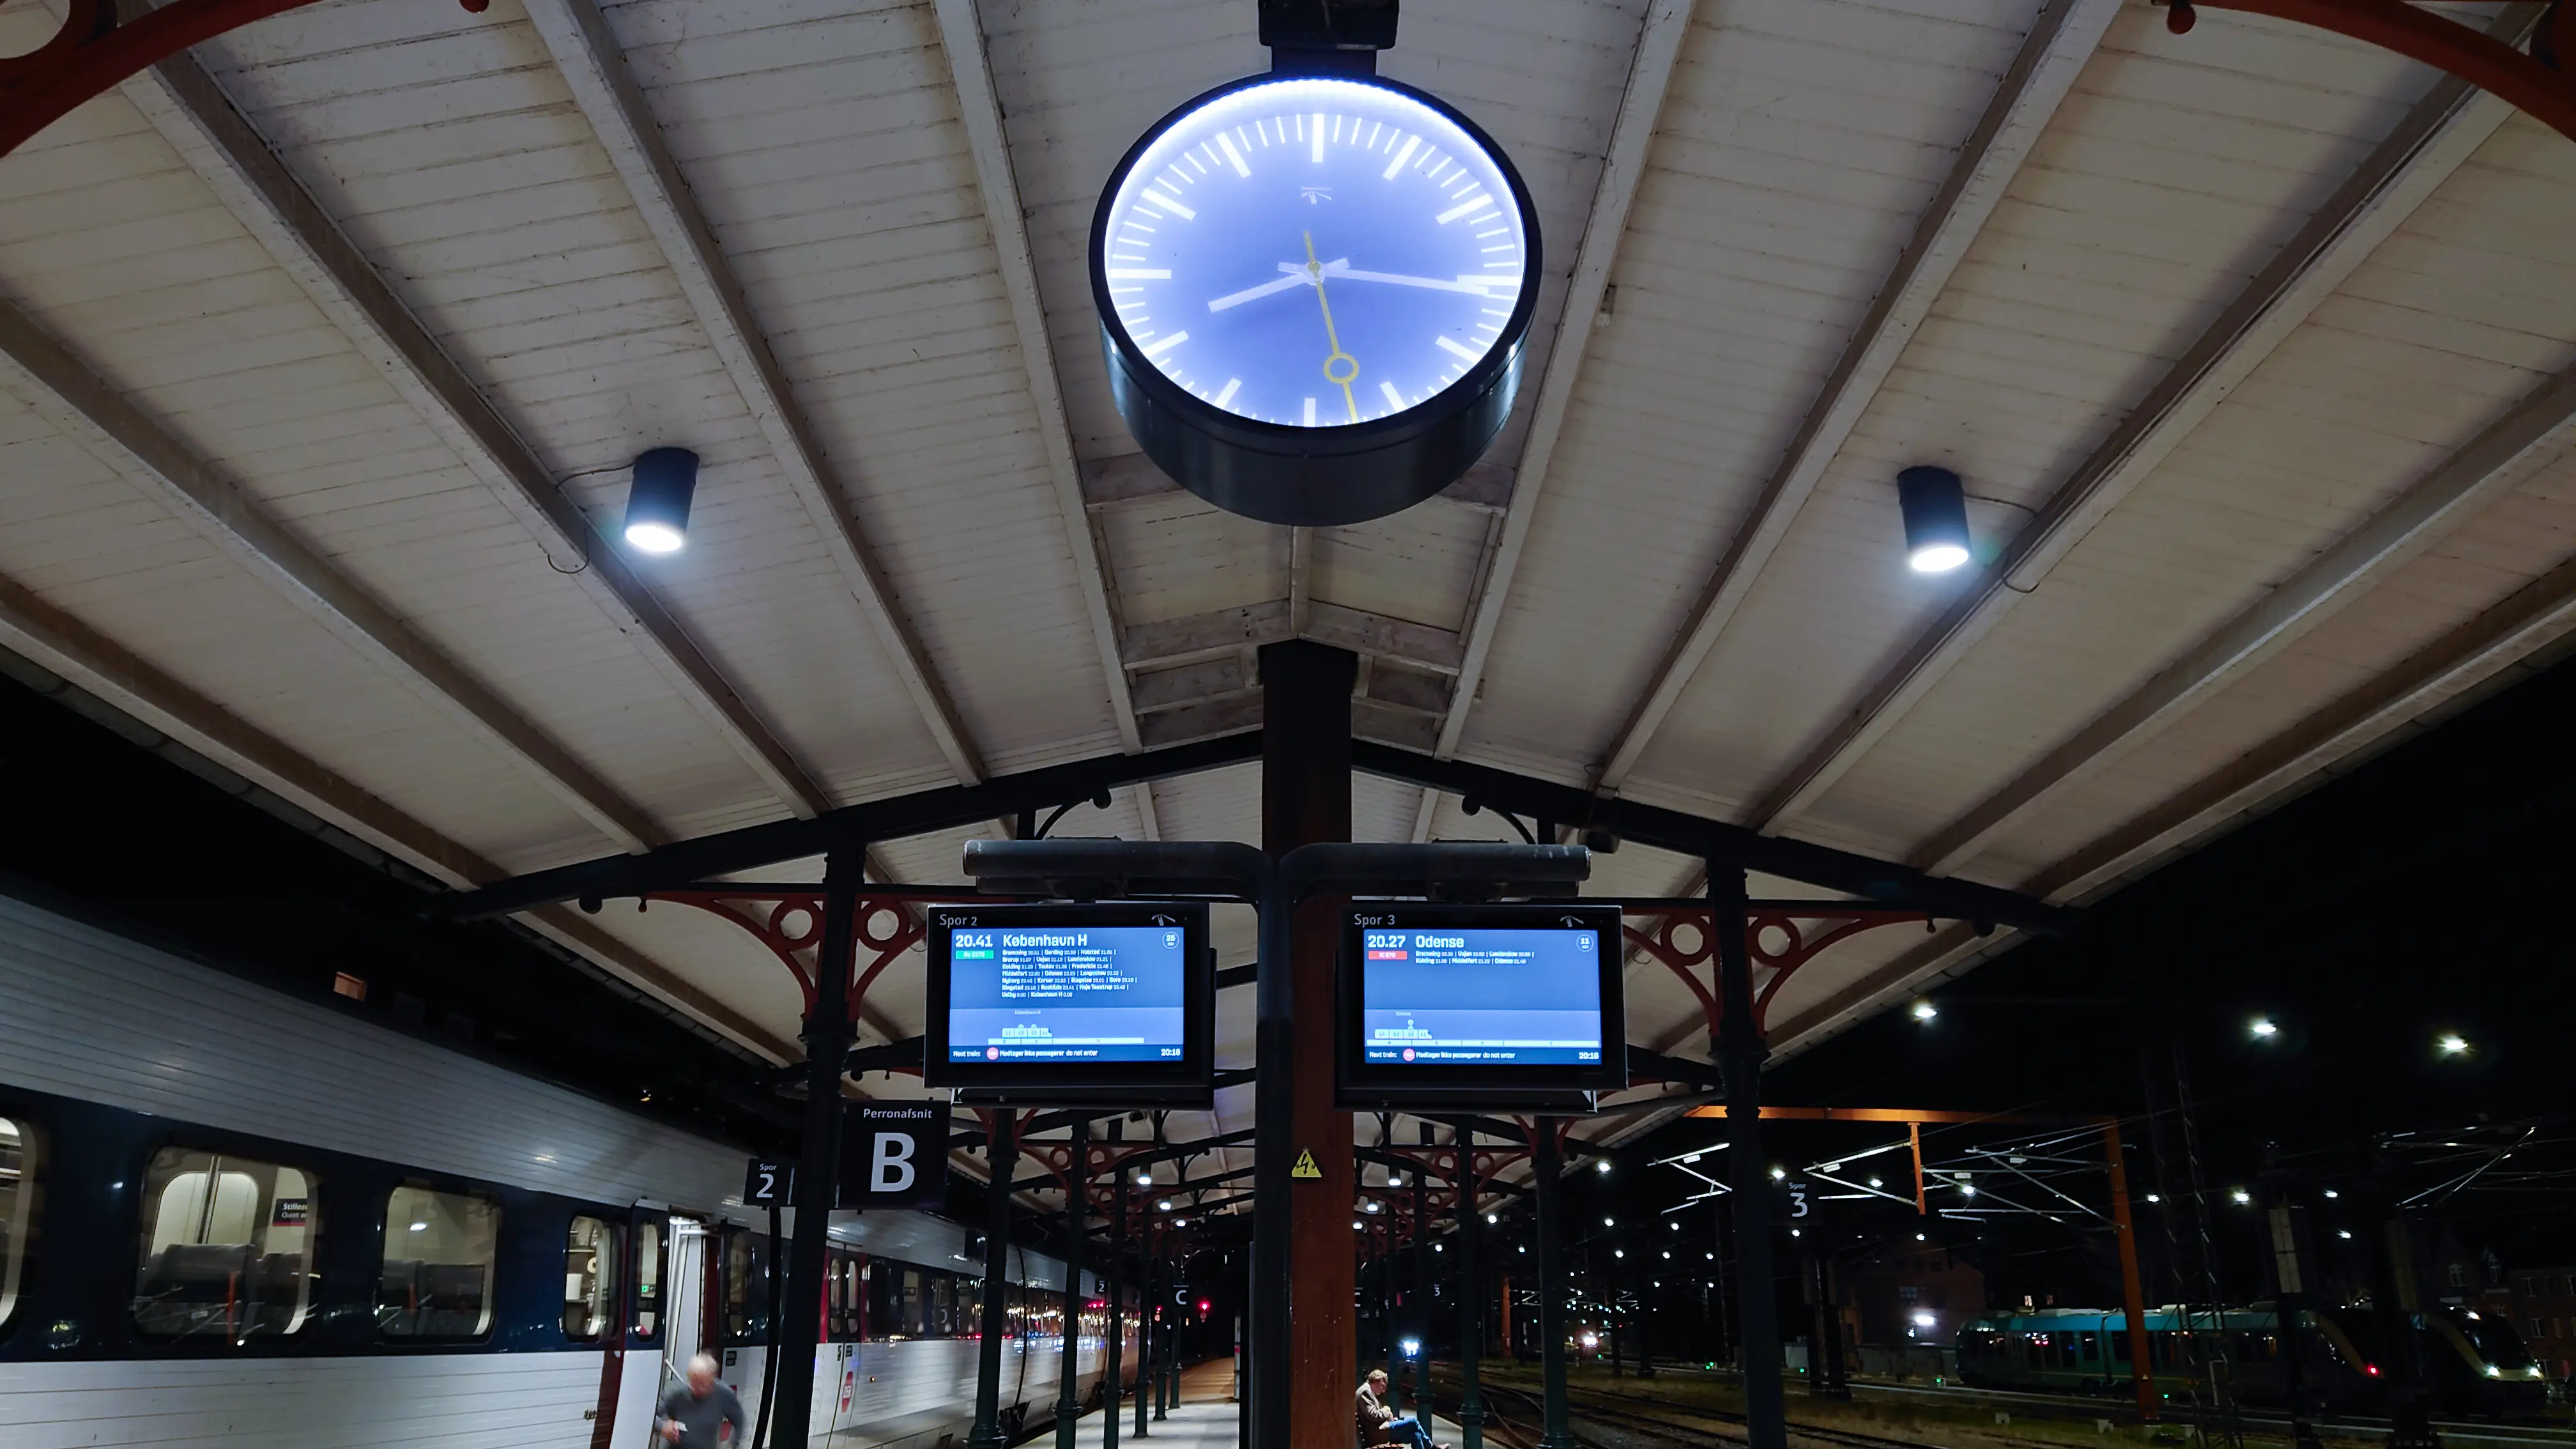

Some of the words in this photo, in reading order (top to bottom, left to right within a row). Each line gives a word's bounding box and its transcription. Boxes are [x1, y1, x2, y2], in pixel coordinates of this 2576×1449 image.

[939, 914, 967, 928] Spor
[971, 917, 977, 926] 2
[1354, 914, 1382, 928] Spor
[1388, 916, 1395, 925] 3
[955, 934, 993, 947] 20.41
[1003, 934, 1075, 947] København
[1078, 935, 1087, 947] H
[1368, 935, 1406, 947] 20.27
[1416, 935, 1464, 948] Odense
[863, 1108, 932, 1119] Perronafsnit
[759, 1163, 777, 1172] Spor
[870, 1132, 916, 1192] B
[756, 1173, 774, 1198] 2
[1788, 1182, 1806, 1190] Spor
[1790, 1192, 1808, 1218] 3
[1098, 1284, 1105, 1292] 2
[1434, 1287, 1440, 1296] 3
[1176, 1290, 1186, 1305] C
